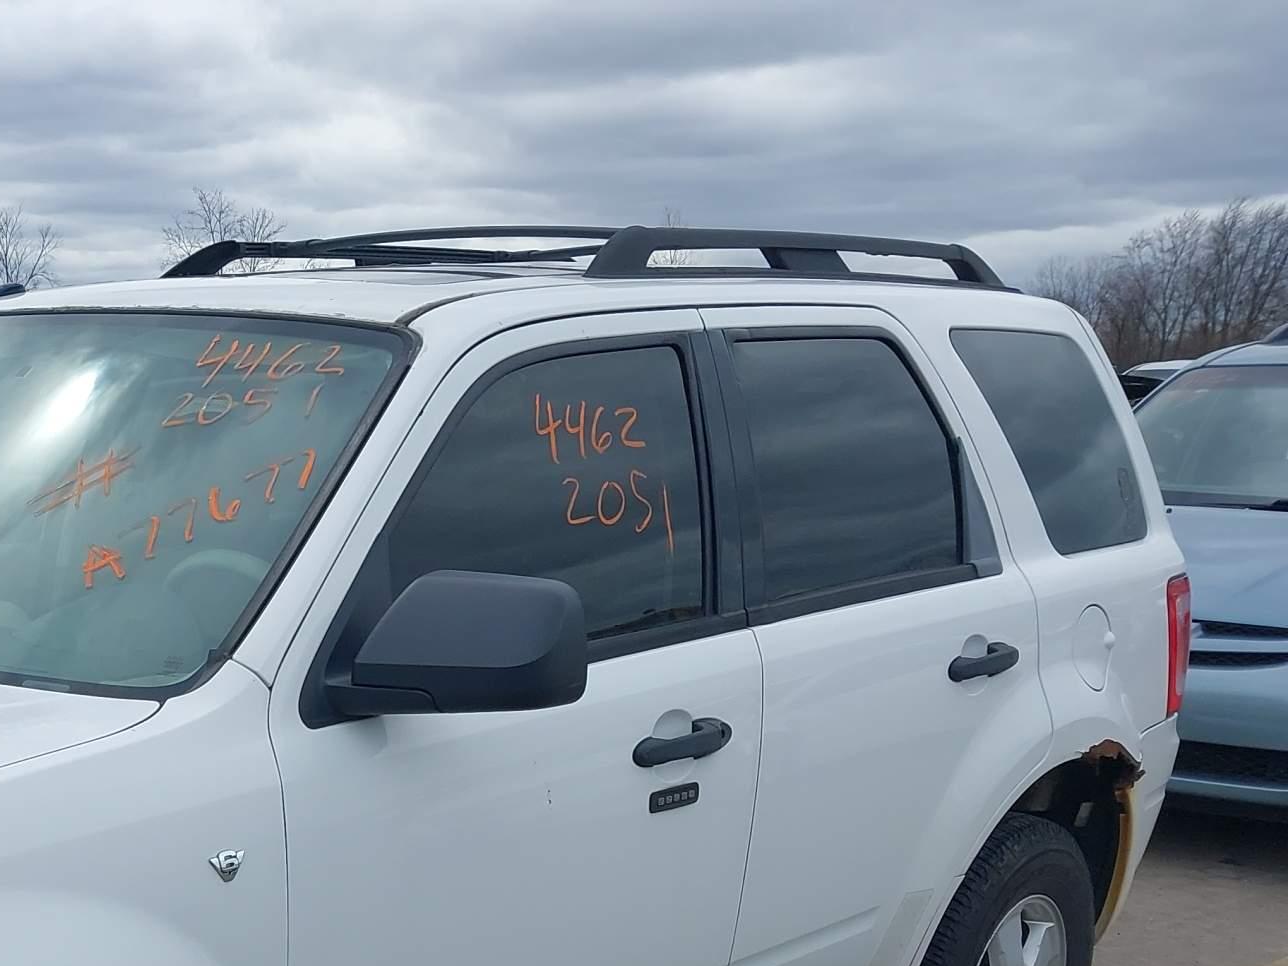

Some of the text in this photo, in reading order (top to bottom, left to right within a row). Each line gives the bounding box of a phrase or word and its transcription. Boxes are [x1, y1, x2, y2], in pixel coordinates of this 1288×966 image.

[196, 334, 345, 388] 4462
[161, 384, 326, 428] 2051
[534, 393, 647, 464] 4462
[561, 469, 675, 553] 2051
